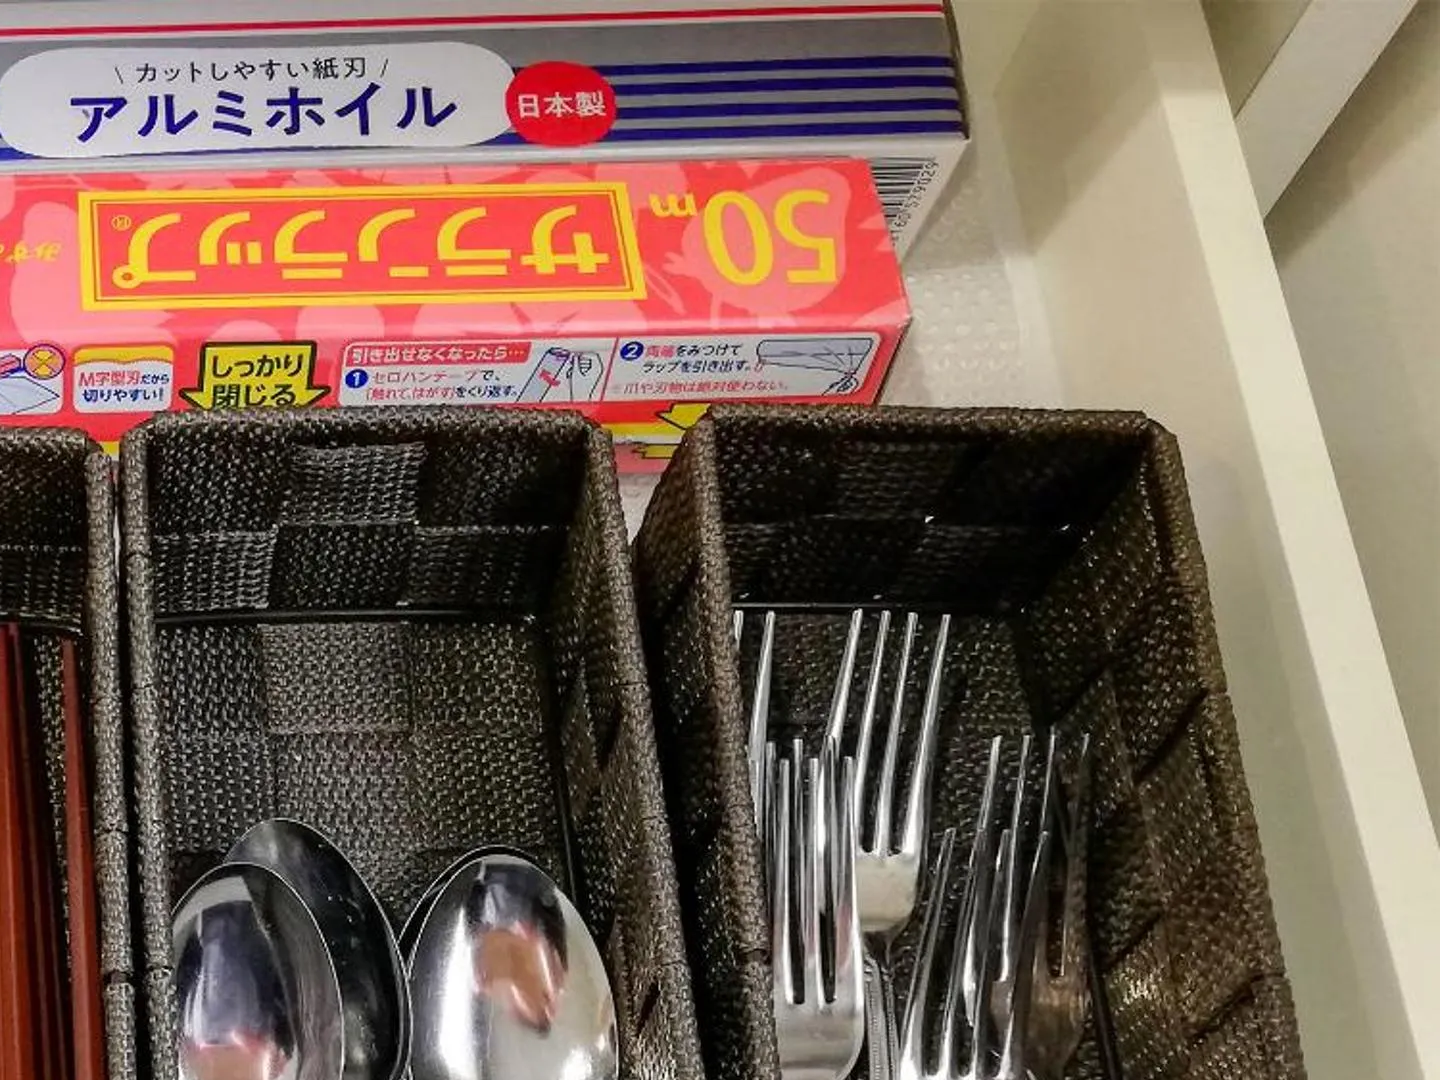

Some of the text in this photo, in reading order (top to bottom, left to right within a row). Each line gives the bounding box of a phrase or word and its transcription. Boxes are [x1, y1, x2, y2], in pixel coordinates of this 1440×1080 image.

[135, 56, 368, 84] カットしやすい紙刃
[68, 82, 458, 143] アルミホイル
[517, 90, 606, 119] 日本製
[649, 189, 840, 287] 50m
[212, 353, 304, 379] しっかり
[212, 382, 298, 409] 閉じる
